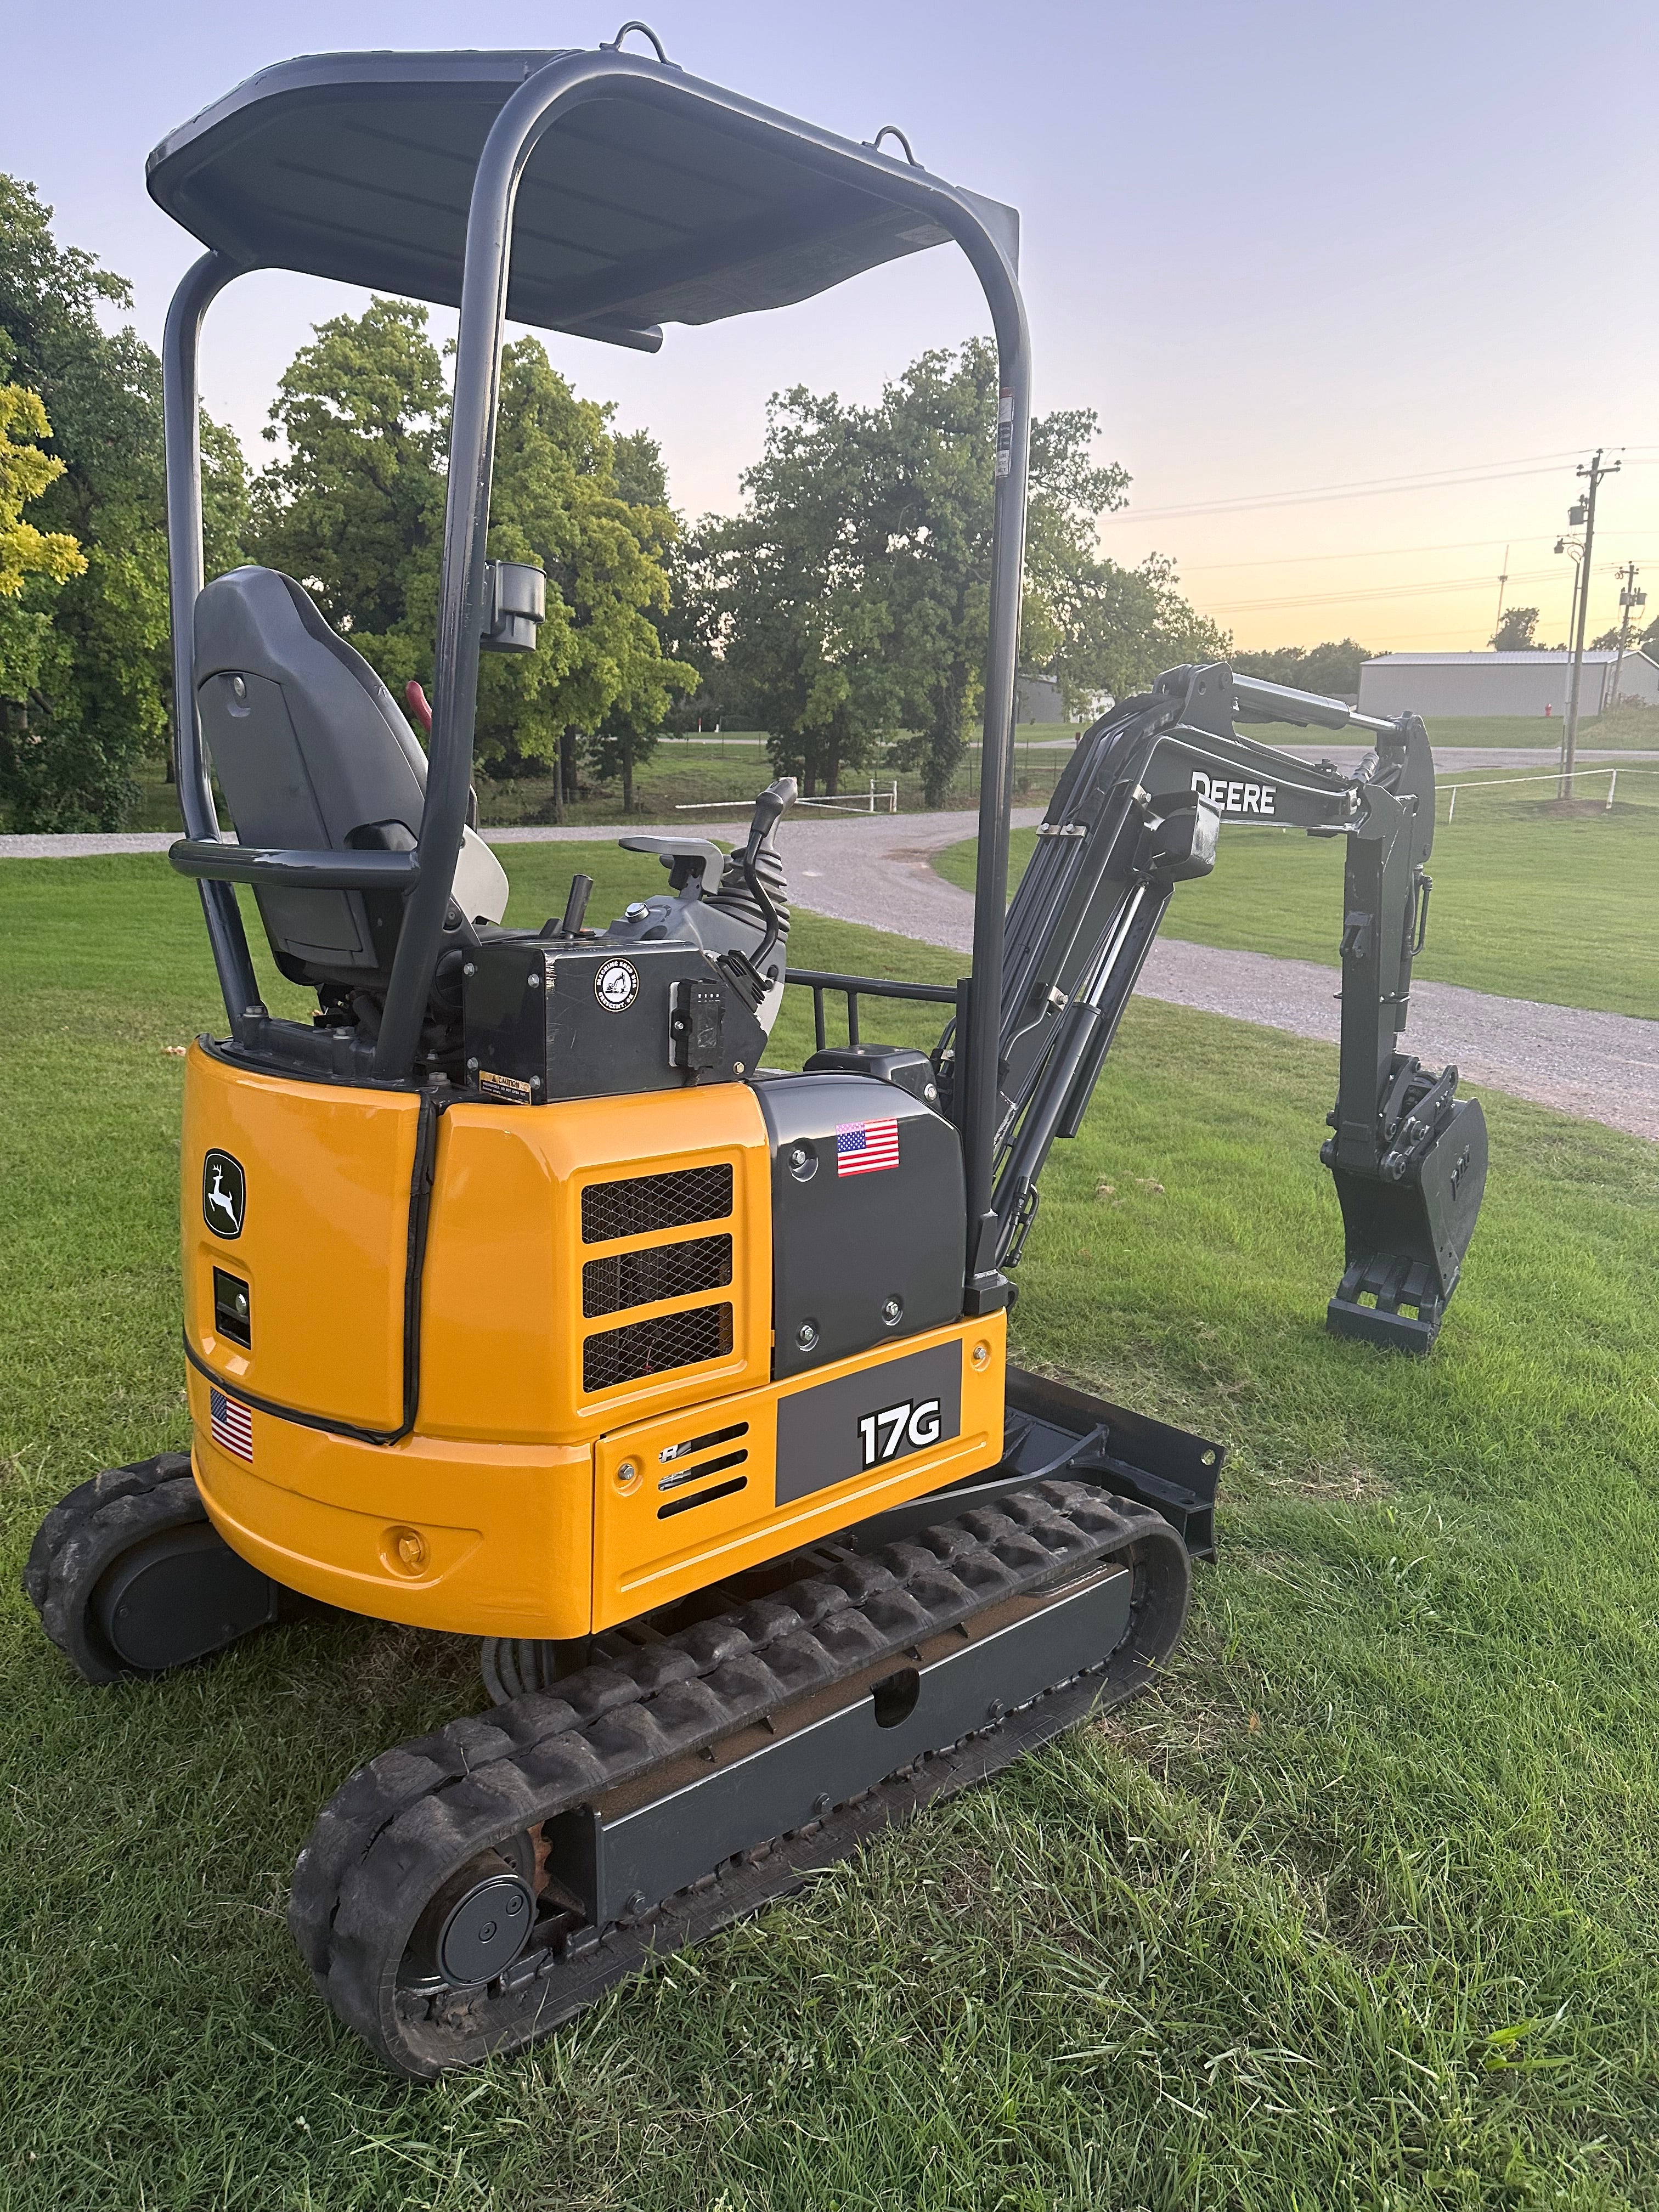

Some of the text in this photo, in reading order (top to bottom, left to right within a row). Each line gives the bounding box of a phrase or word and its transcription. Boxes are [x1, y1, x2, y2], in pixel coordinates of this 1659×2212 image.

[1191, 771, 1277, 814] DEERE
[597, 961, 618, 985] MACHINE
[619, 962, 633, 973] SHED
[626, 994, 634, 1003] OK
[499, 1077, 520, 1088] CAUTION
[860, 1401, 939, 1464] 17G
